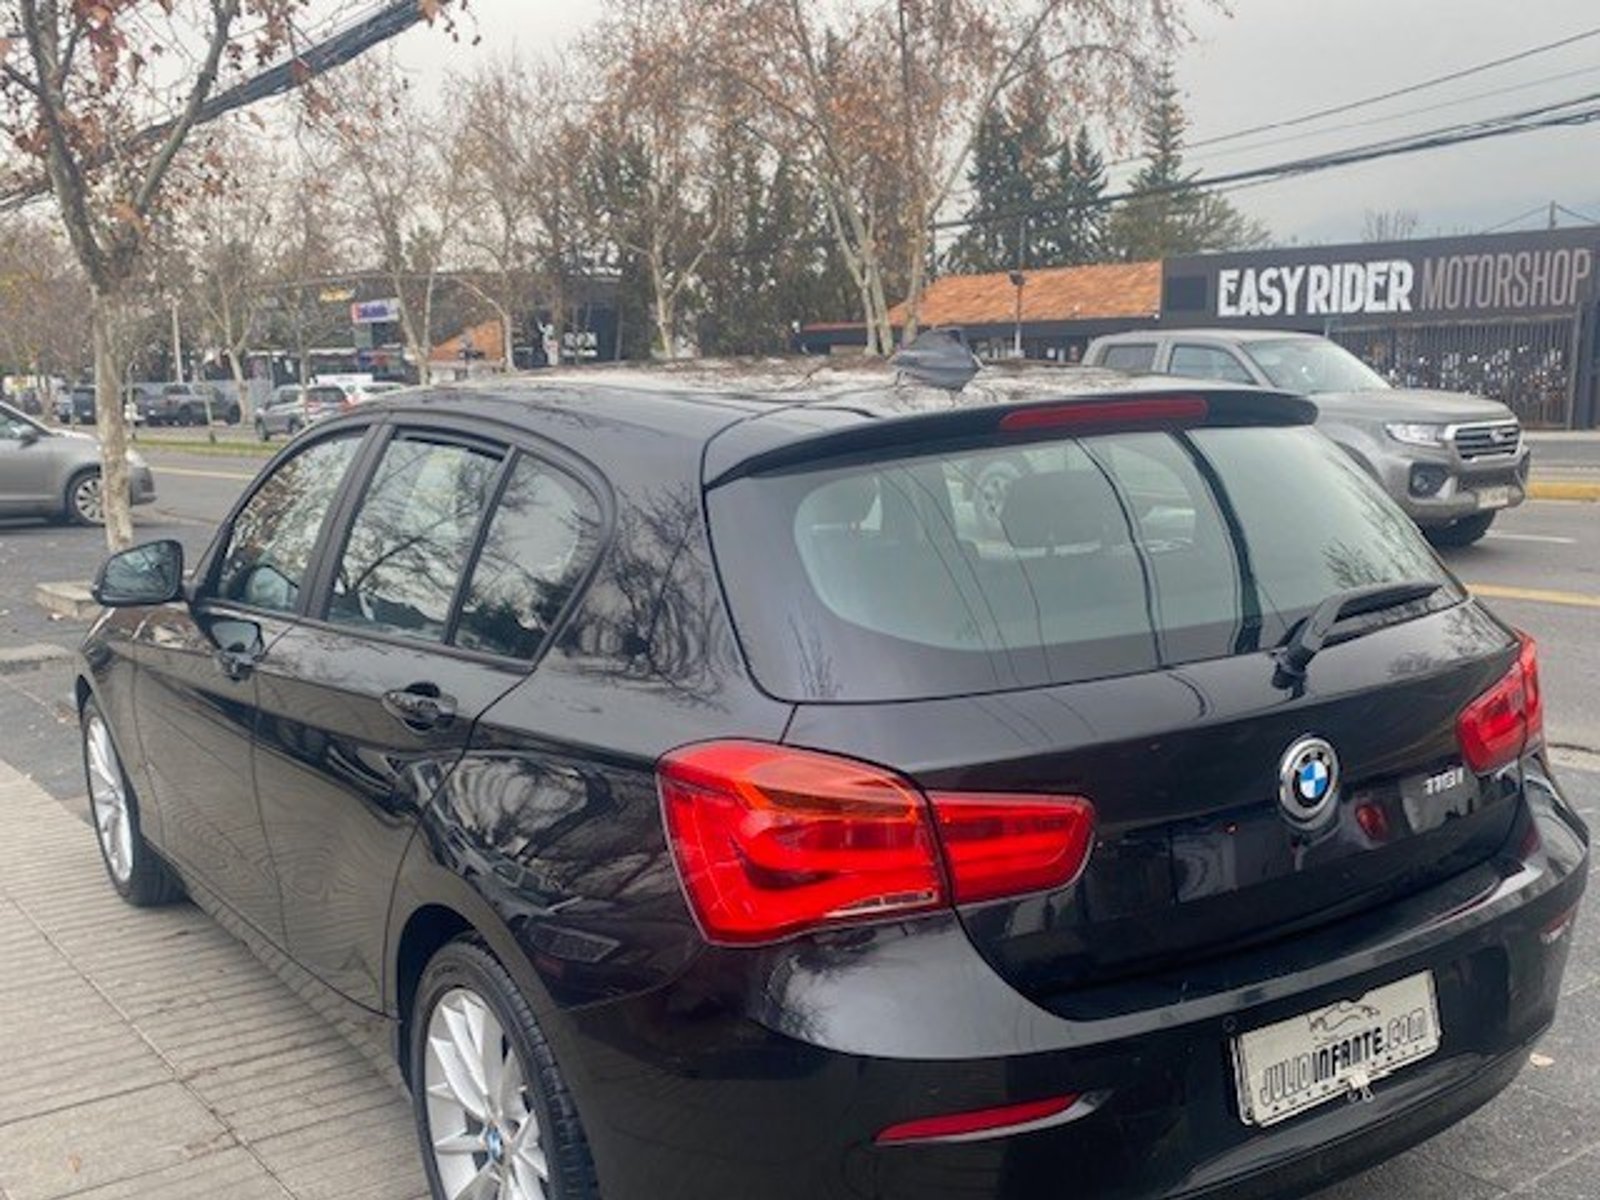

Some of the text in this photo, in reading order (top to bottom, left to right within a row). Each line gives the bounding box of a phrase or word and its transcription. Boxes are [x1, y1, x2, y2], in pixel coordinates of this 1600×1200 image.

[1218, 249, 1591, 317] EASY RIDER MOTORSHOP
